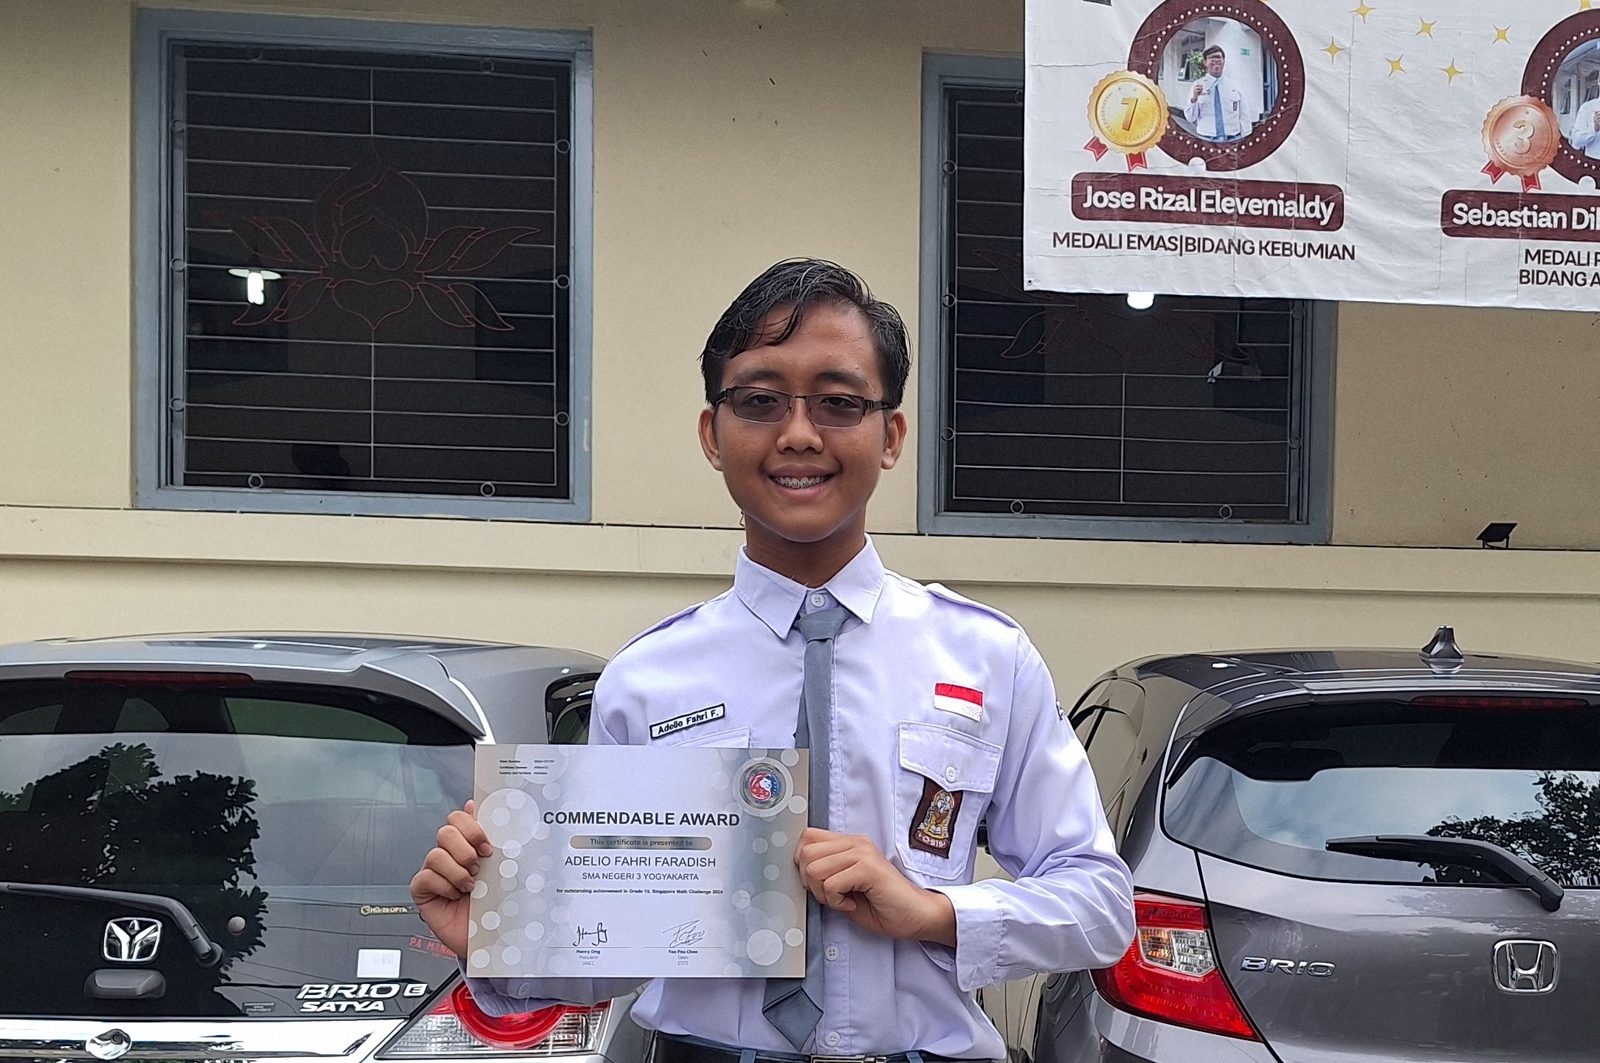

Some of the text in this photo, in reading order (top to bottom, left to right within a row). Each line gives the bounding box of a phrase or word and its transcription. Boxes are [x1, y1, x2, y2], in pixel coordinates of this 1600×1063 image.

[1512, 119, 1536, 155] 3
[1082, 185, 1336, 226] Jose Rizal Elevenialdy
[1452, 202, 1568, 230] Sebastian
[1052, 231, 1123, 250] MEDALI
[1258, 239, 1356, 261] KEBUMIAN
[1524, 248, 1590, 267] MEDALI
[1519, 269, 1587, 287] BIDANG
[686, 711, 708, 725] Fahri
[710, 709, 719, 718] F.
[543, 811, 740, 826] COMMENDABLE AWARD
[589, 838, 604, 846] This
[606, 838, 641, 847] certificate
[642, 839, 649, 847] is
[649, 839, 684, 848] presented
[564, 856, 716, 868] ADELIO FAHRI FARADISH
[582, 872, 600, 880] SMA
[602, 872, 635, 881] NEGERI
[643, 873, 699, 881] YOGYAKARTA
[1240, 956, 1336, 977] BRIO
[296, 983, 401, 1000] BRIO
[299, 1000, 385, 1013] SATYA
